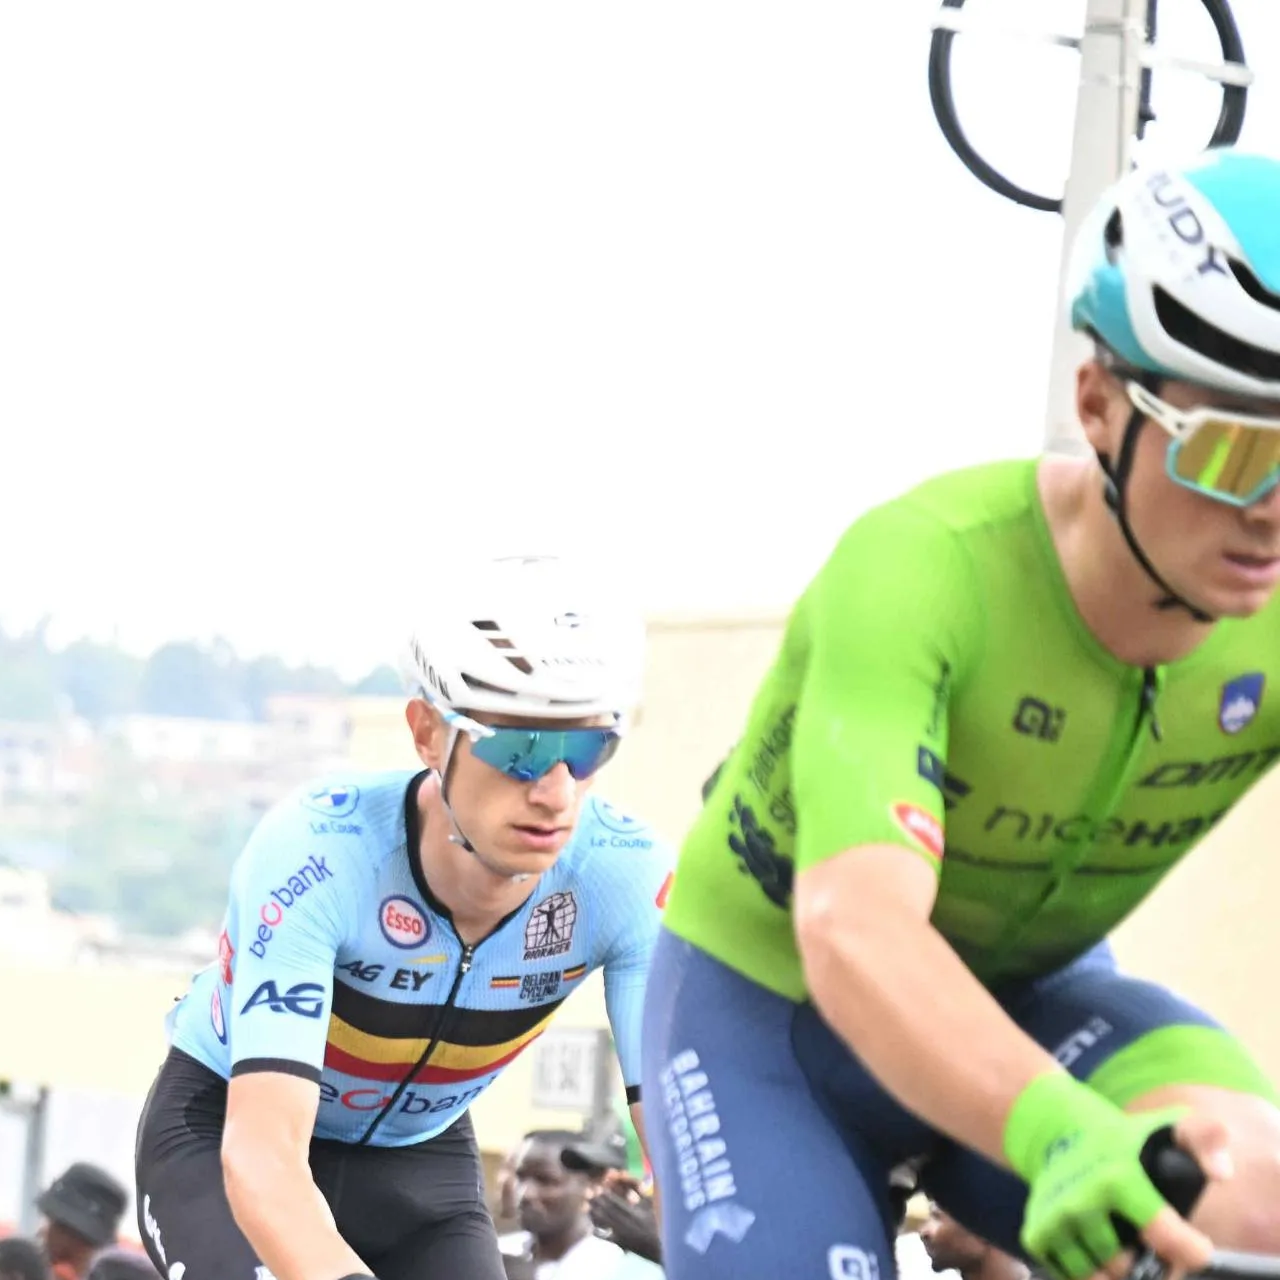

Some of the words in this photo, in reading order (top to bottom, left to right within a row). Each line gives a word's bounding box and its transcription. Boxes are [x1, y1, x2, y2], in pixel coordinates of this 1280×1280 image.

[338, 959, 385, 983] AG
[389, 968, 434, 992] EY
[239, 979, 326, 1019] AG
